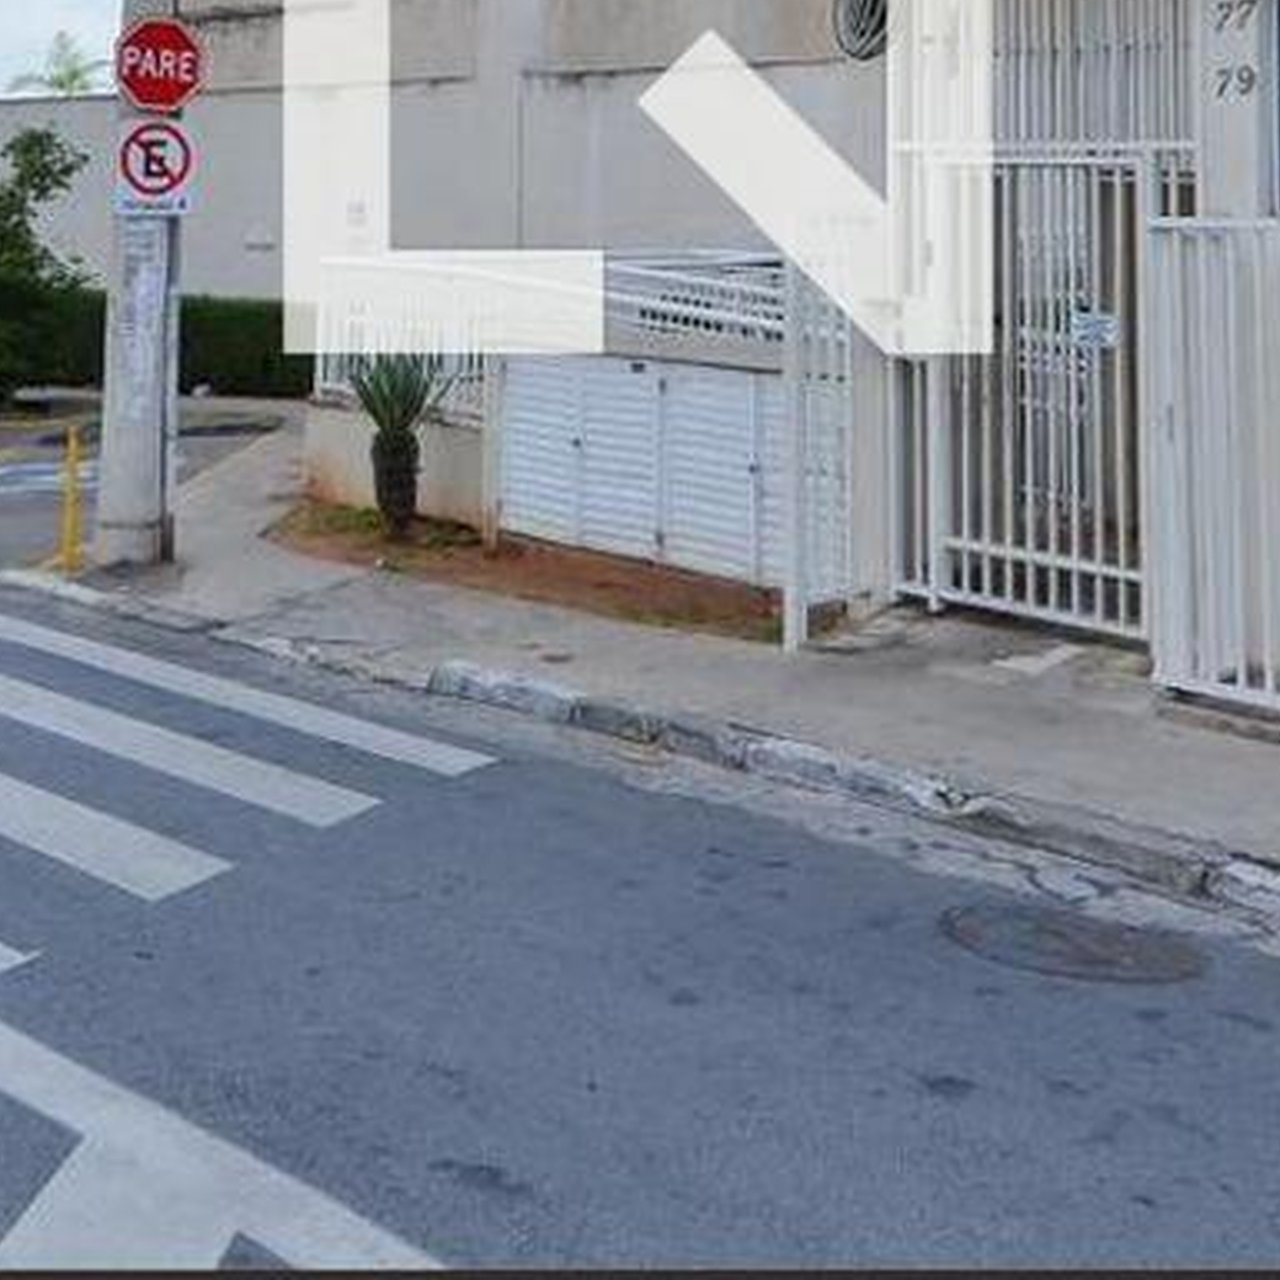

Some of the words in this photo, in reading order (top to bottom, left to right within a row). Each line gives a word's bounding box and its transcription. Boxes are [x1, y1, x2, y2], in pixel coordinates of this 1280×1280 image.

[1215, 0, 1257, 32] 77
[122, 46, 197, 82] PARE
[1216, 64, 1255, 98] 79
